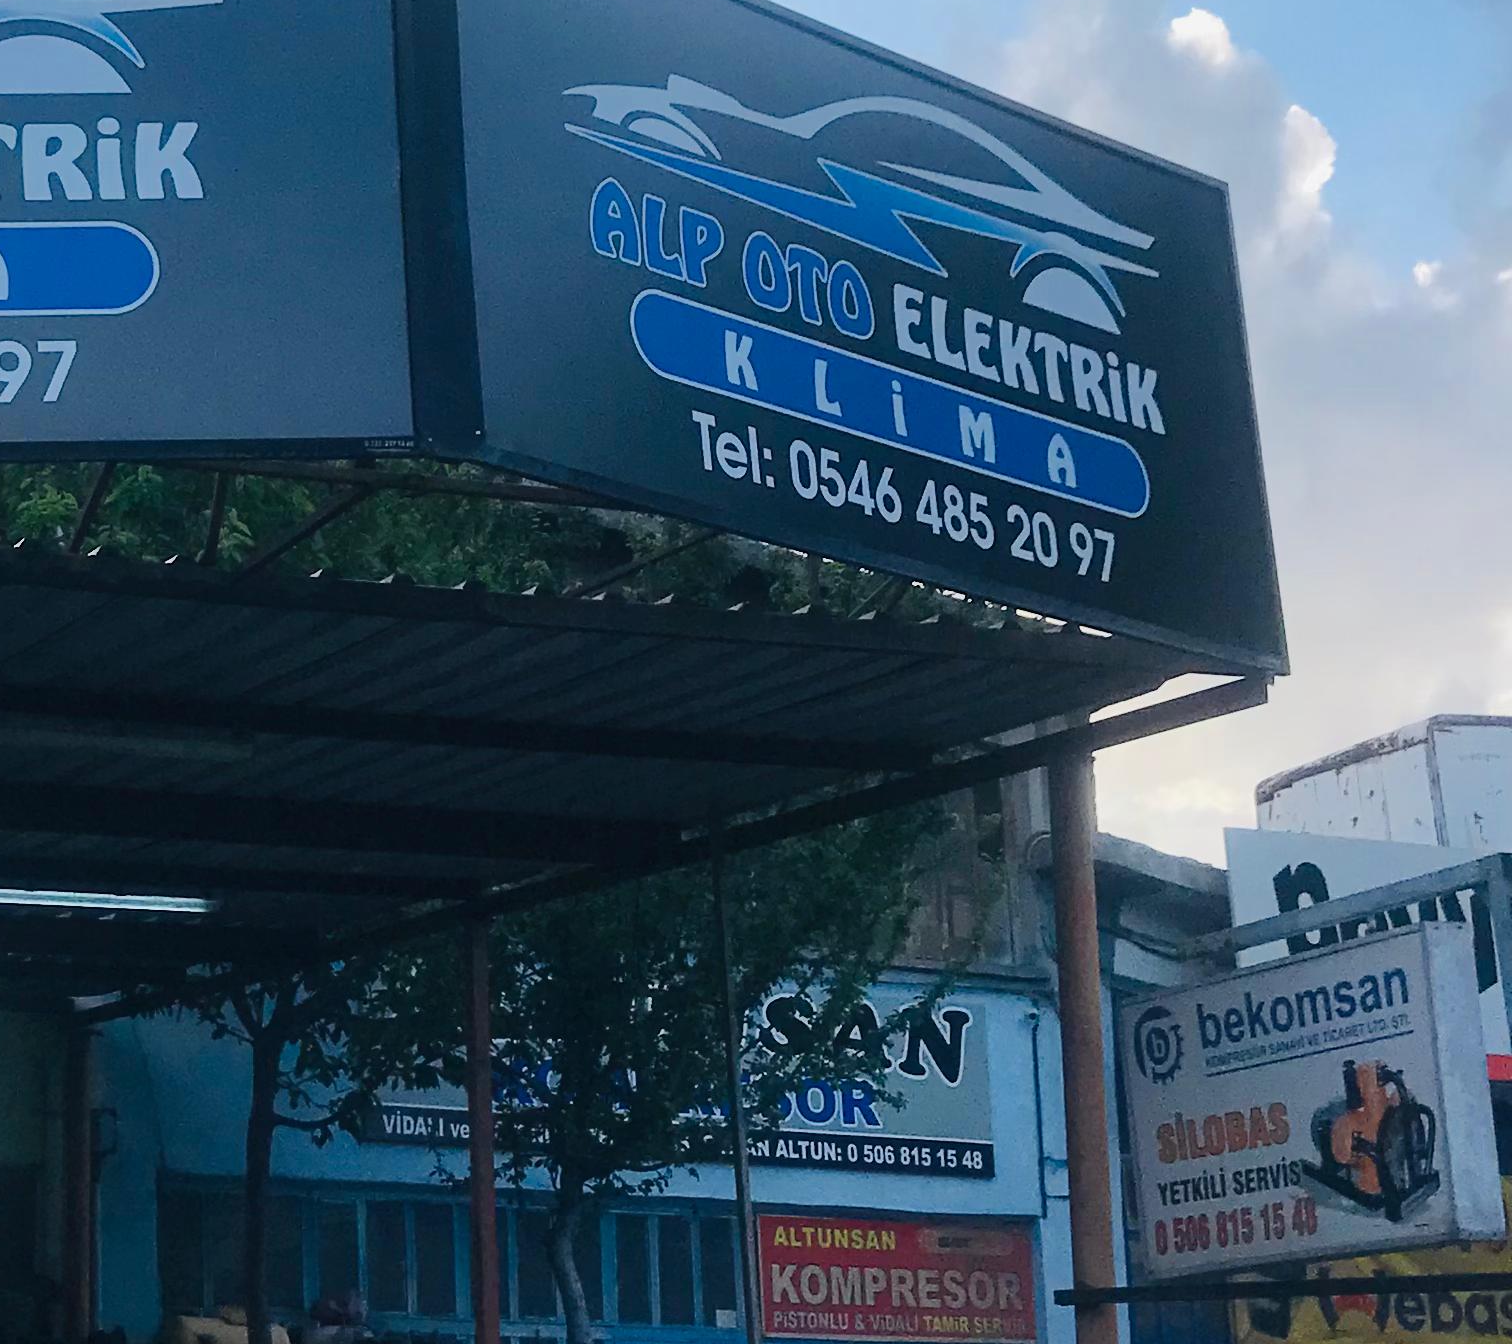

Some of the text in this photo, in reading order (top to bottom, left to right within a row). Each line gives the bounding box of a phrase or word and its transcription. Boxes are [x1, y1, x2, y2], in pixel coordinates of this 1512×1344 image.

[589, 177, 725, 288] ALP
[742, 231, 875, 340] OTO
[691, 411, 1116, 583] Tel: 0546 485 20 97
[1196, 967, 1409, 1049] bekomsan
[776, 1139, 842, 1162] ALTUN:
[847, 1143, 858, 1163] 0
[864, 1144, 895, 1165] 506
[901, 1146, 931, 1167] 815
[938, 1148, 957, 1169] 15
[963, 1150, 983, 1171] 48
[1157, 1102, 1290, 1163] SİLOBAS
[1157, 1156, 1303, 1206] YETKİLİ SERVİS
[774, 1226, 896, 1251] ALTUNSAN
[1155, 1218, 1168, 1256] 0
[1173, 1213, 1210, 1254] 506
[1216, 1207, 1254, 1248] 815
[1260, 1202, 1285, 1241] 15
[771, 1263, 1024, 1311] KOMPRESOR
[855, 1312, 865, 1331] &
